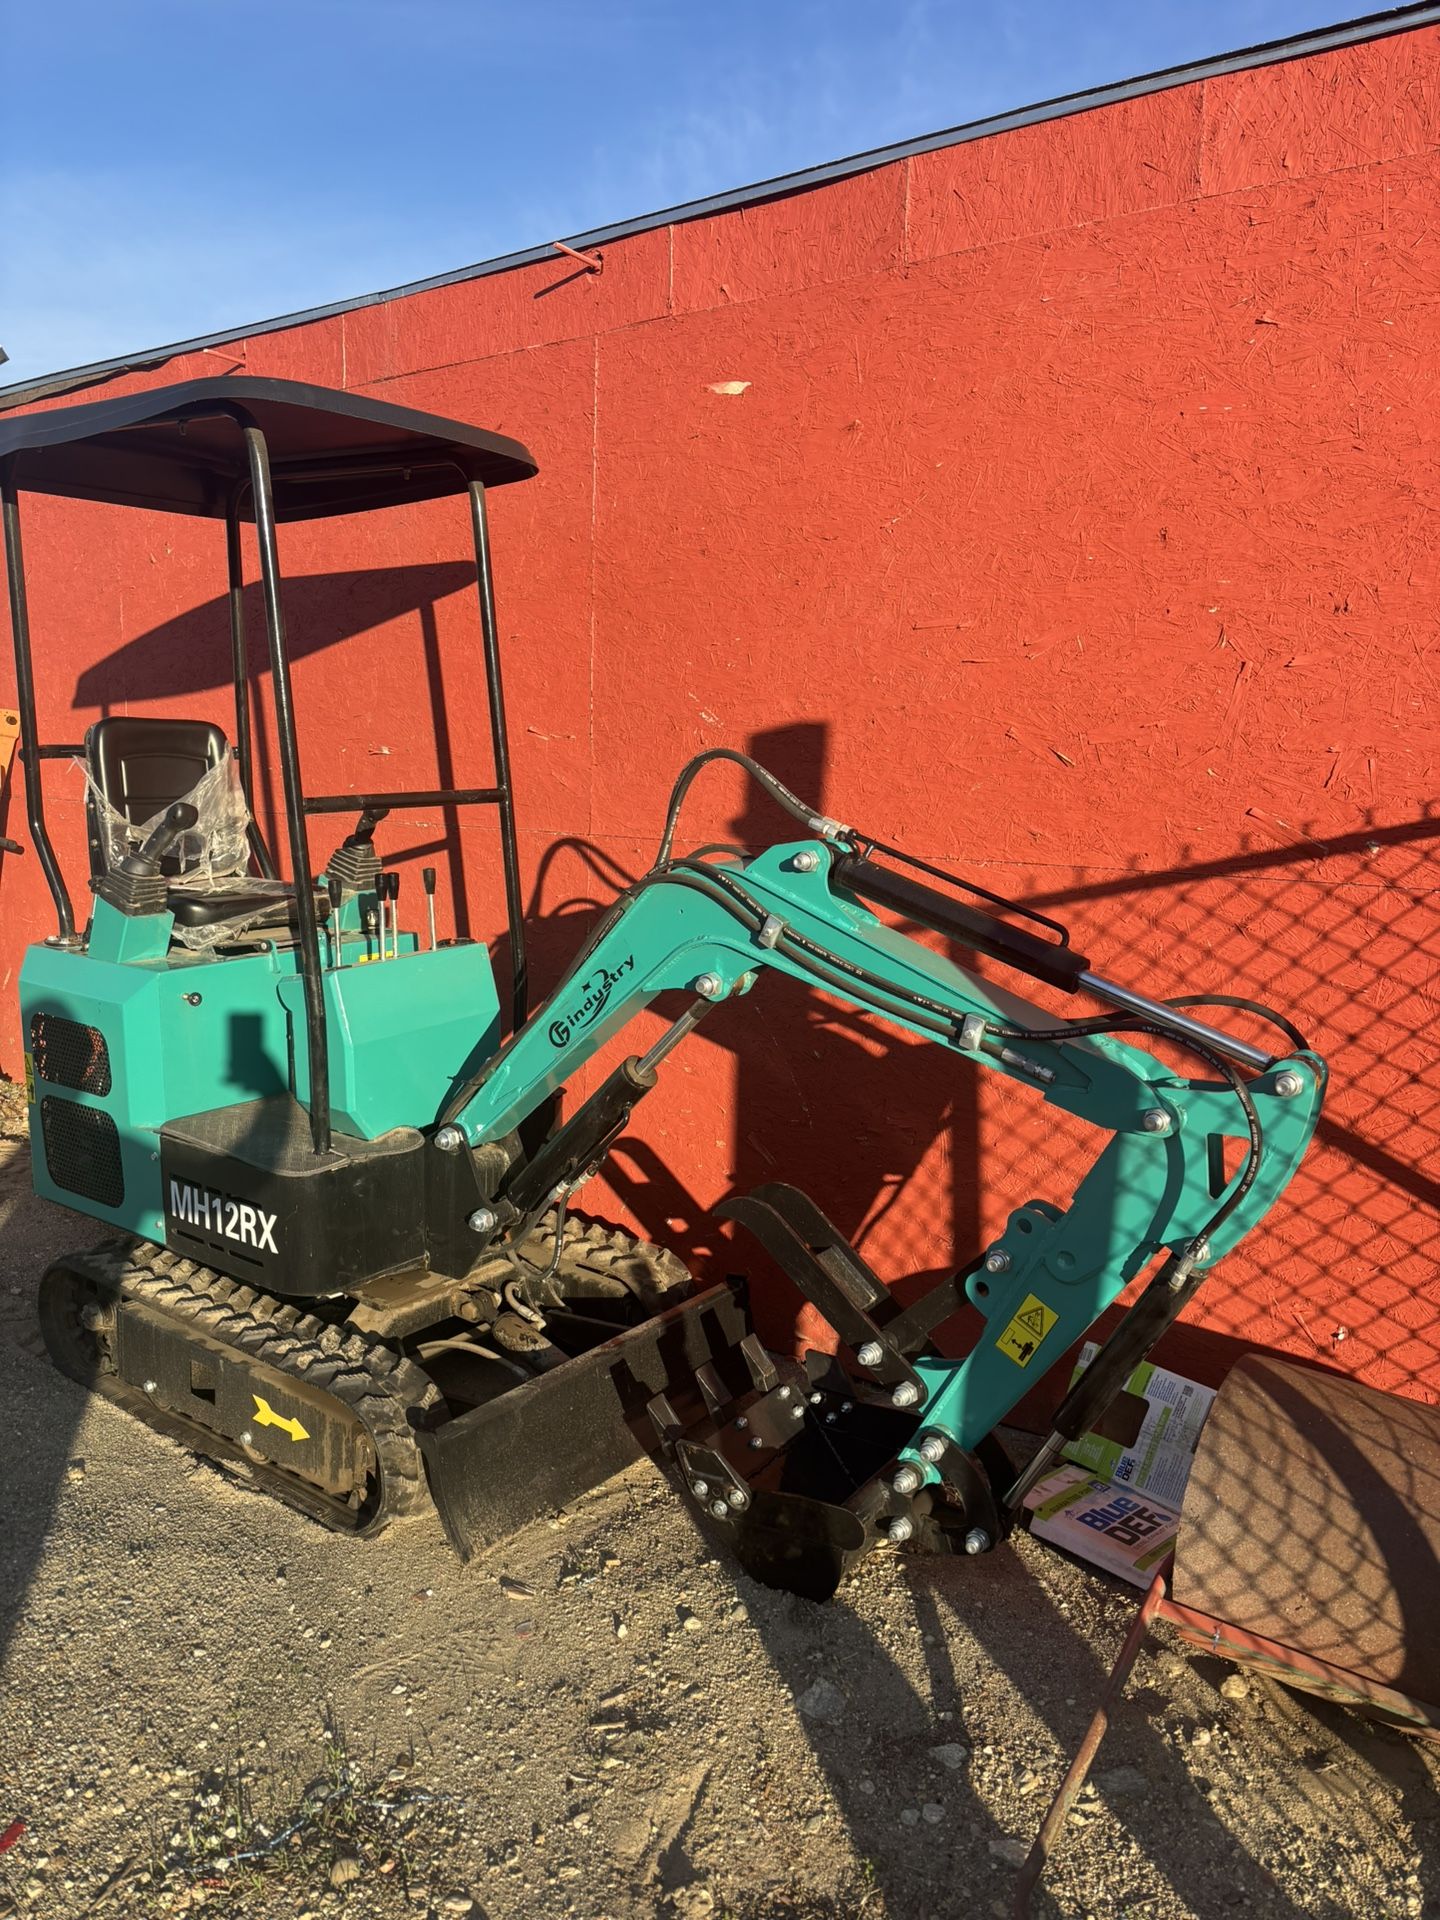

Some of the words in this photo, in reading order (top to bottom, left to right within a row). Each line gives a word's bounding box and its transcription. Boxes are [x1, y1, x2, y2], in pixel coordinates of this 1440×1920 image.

[170, 1180, 279, 1254] MH12RX
[1075, 1496, 1142, 1532] Blue
[1103, 1506, 1163, 1546] DEF
